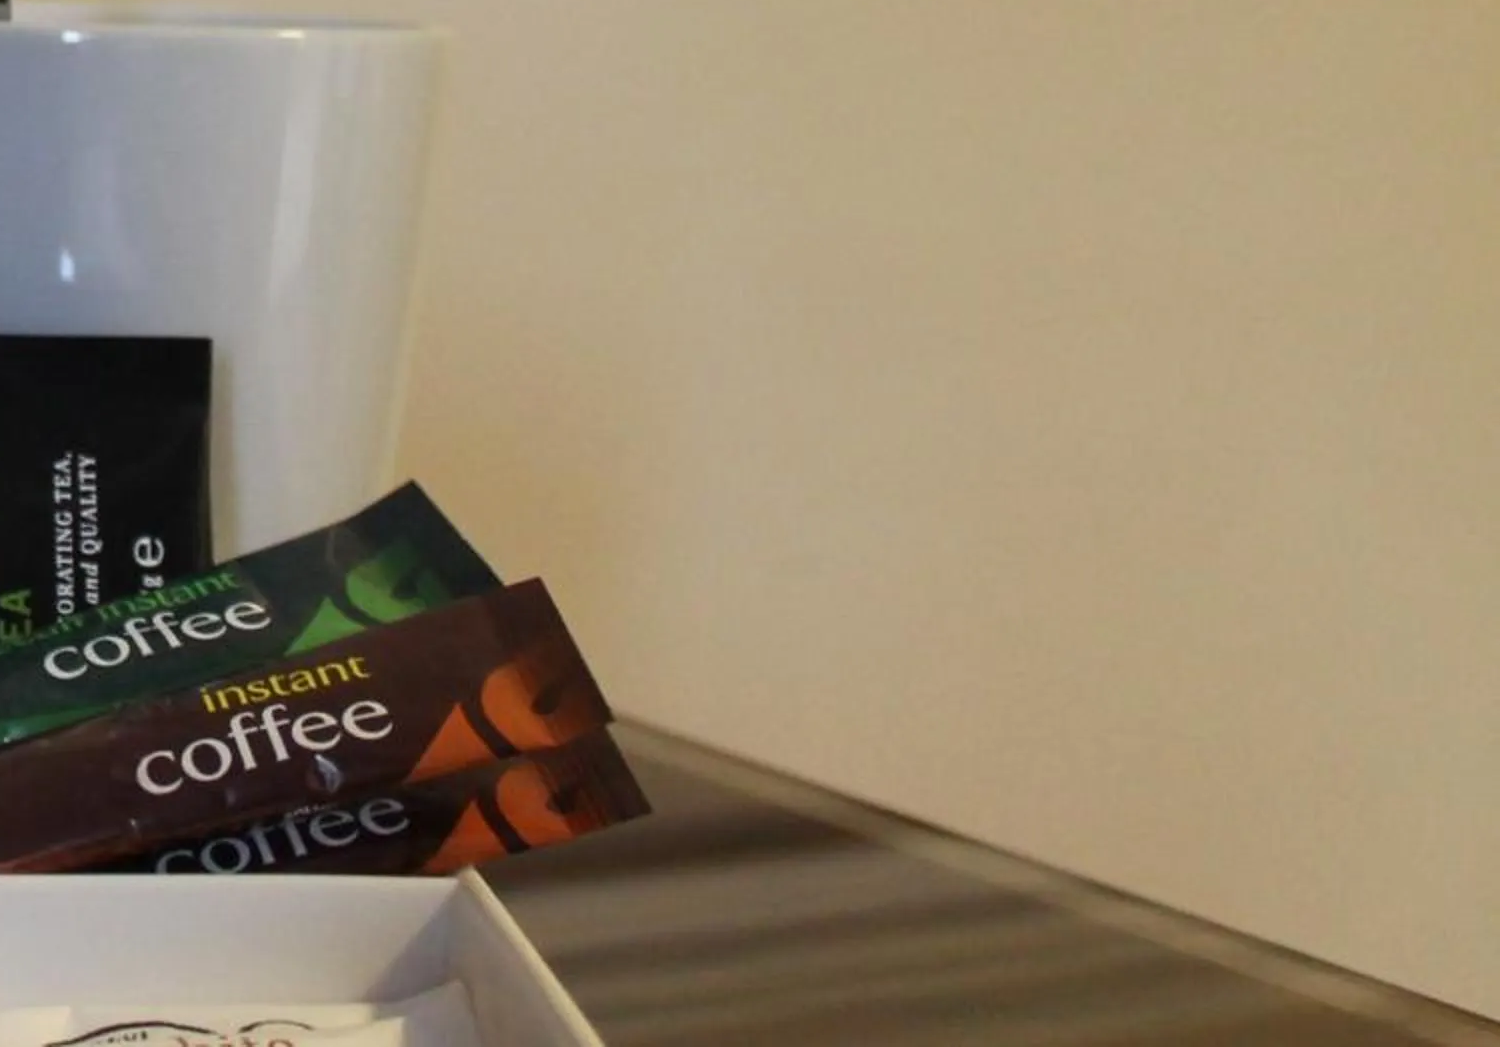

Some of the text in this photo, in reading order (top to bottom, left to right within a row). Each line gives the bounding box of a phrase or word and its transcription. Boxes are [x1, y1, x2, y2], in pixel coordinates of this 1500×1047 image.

[55, 511, 75, 615] ORATING
[78, 454, 103, 605] and QUALITY
[43, 599, 271, 681] coffee
[201, 656, 371, 713] instant
[135, 697, 394, 795] coffee
